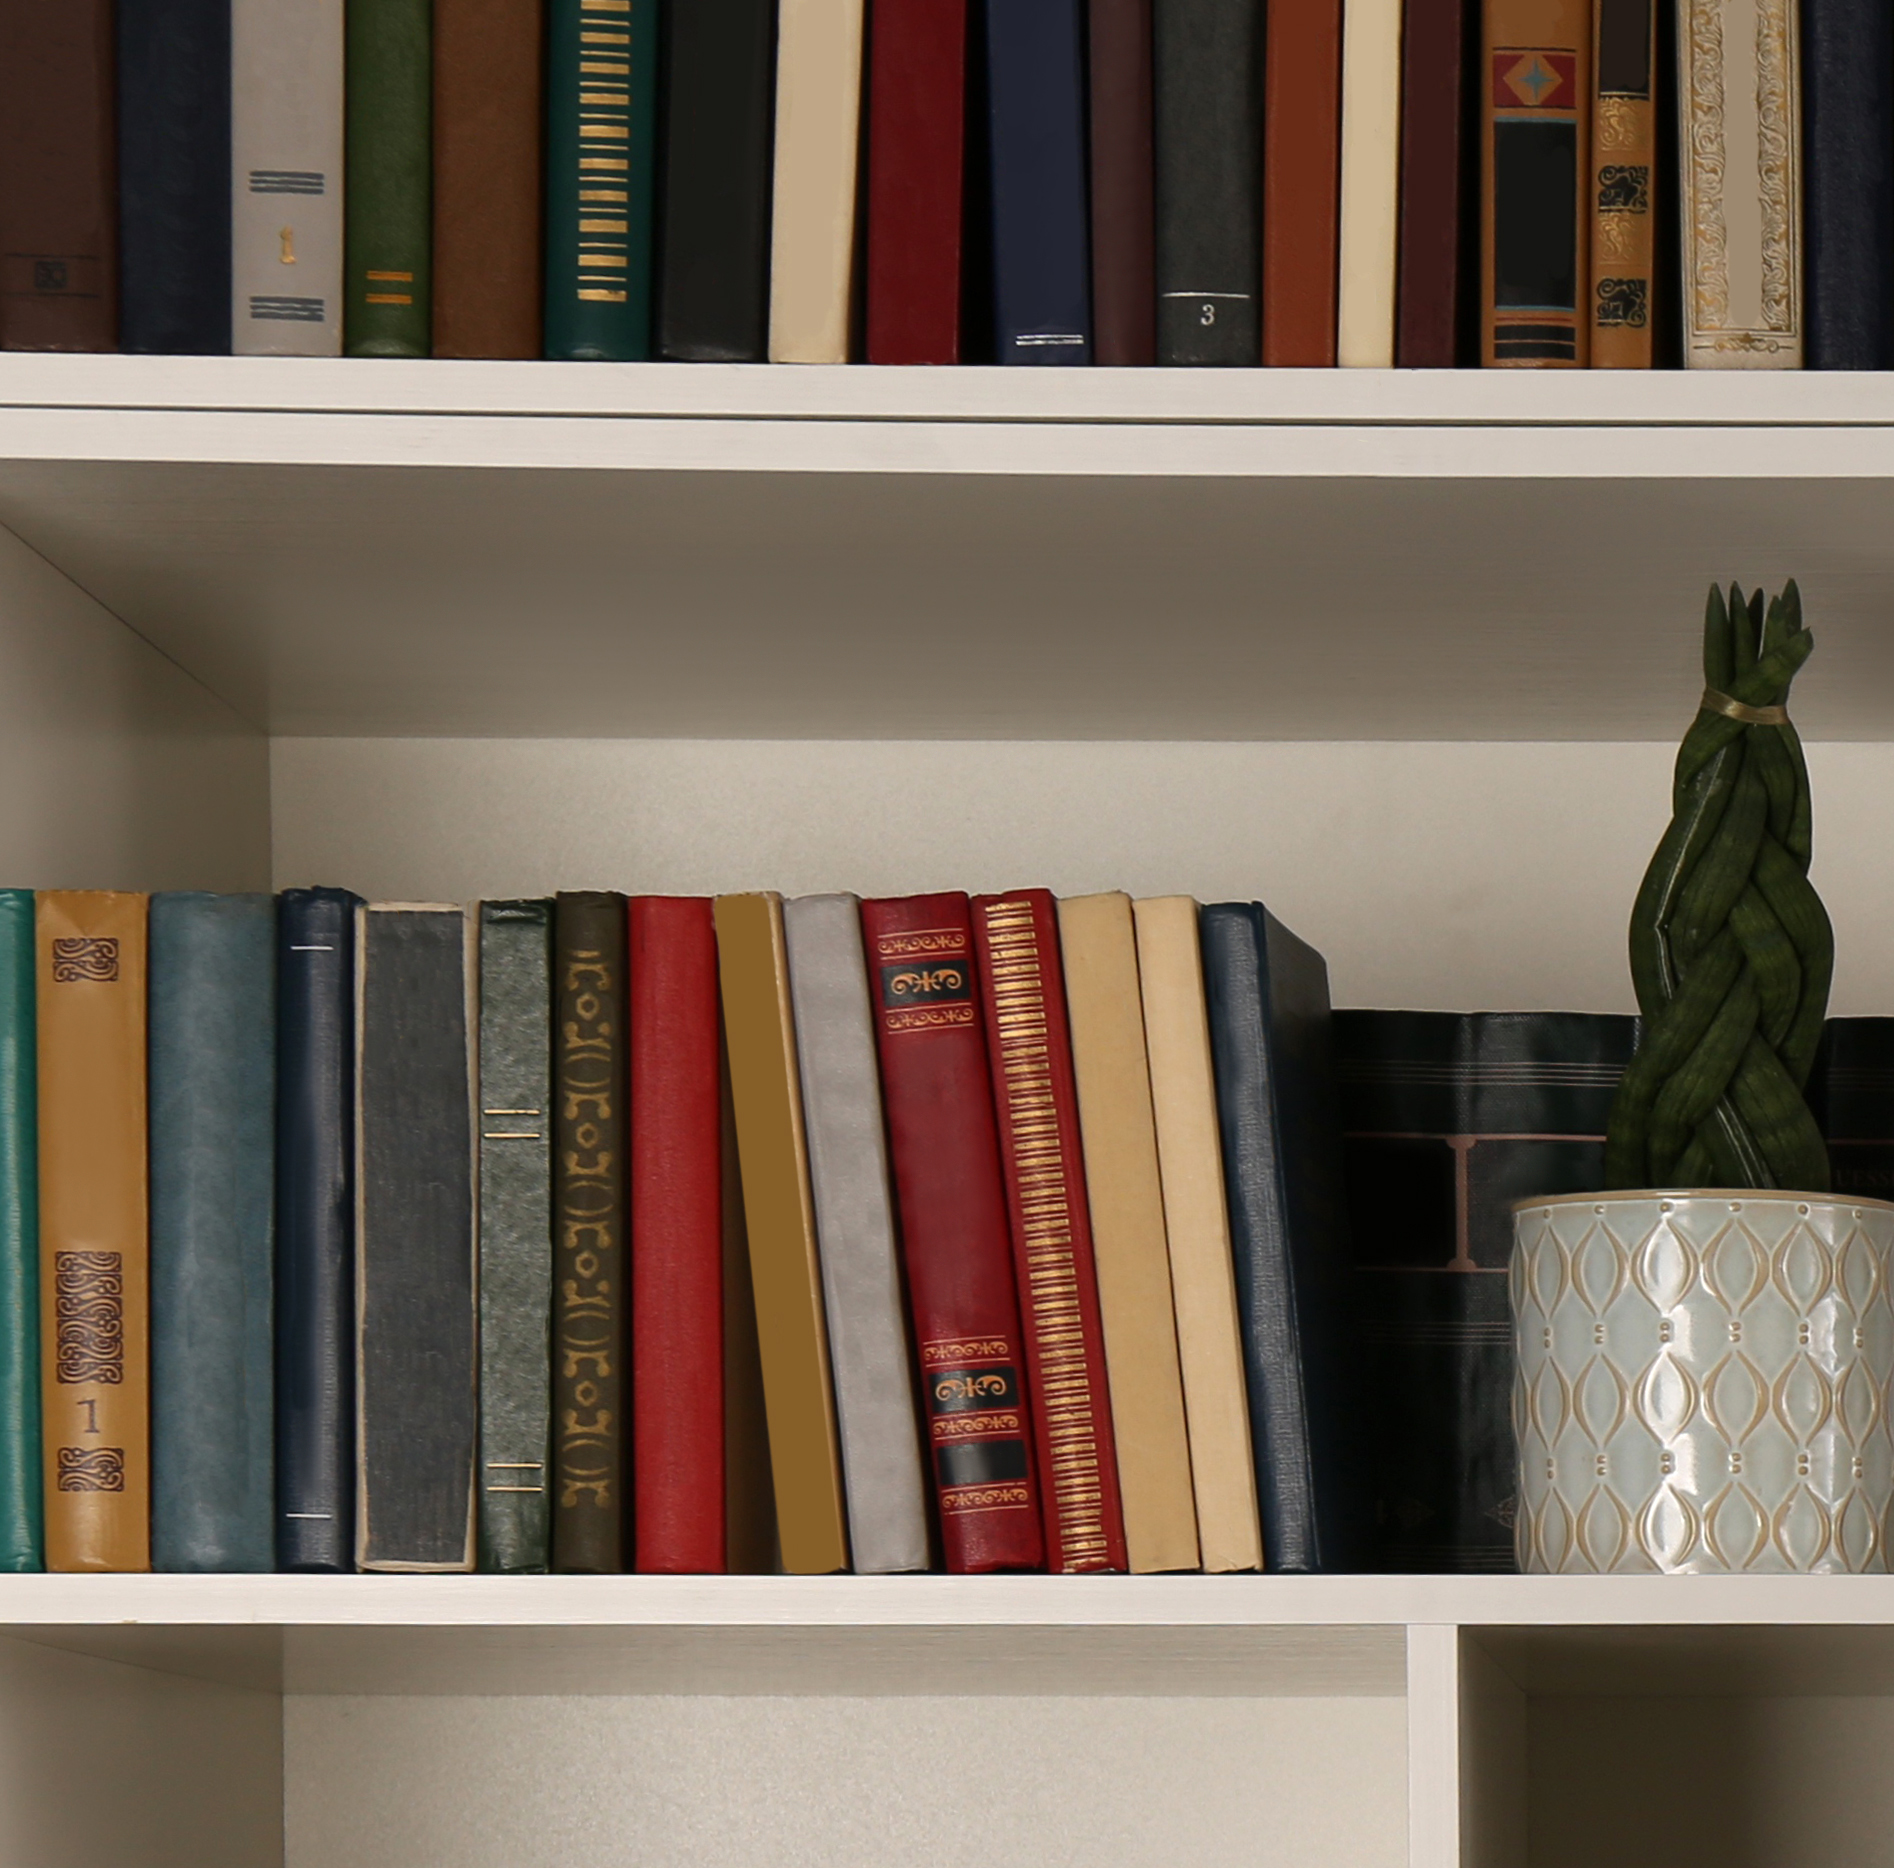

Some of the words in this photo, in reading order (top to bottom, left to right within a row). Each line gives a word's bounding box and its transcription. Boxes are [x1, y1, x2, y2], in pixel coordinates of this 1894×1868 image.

[280, 227, 297, 264] 1
[1200, 304, 1215, 326] 3
[76, 1399, 101, 1433] 1
